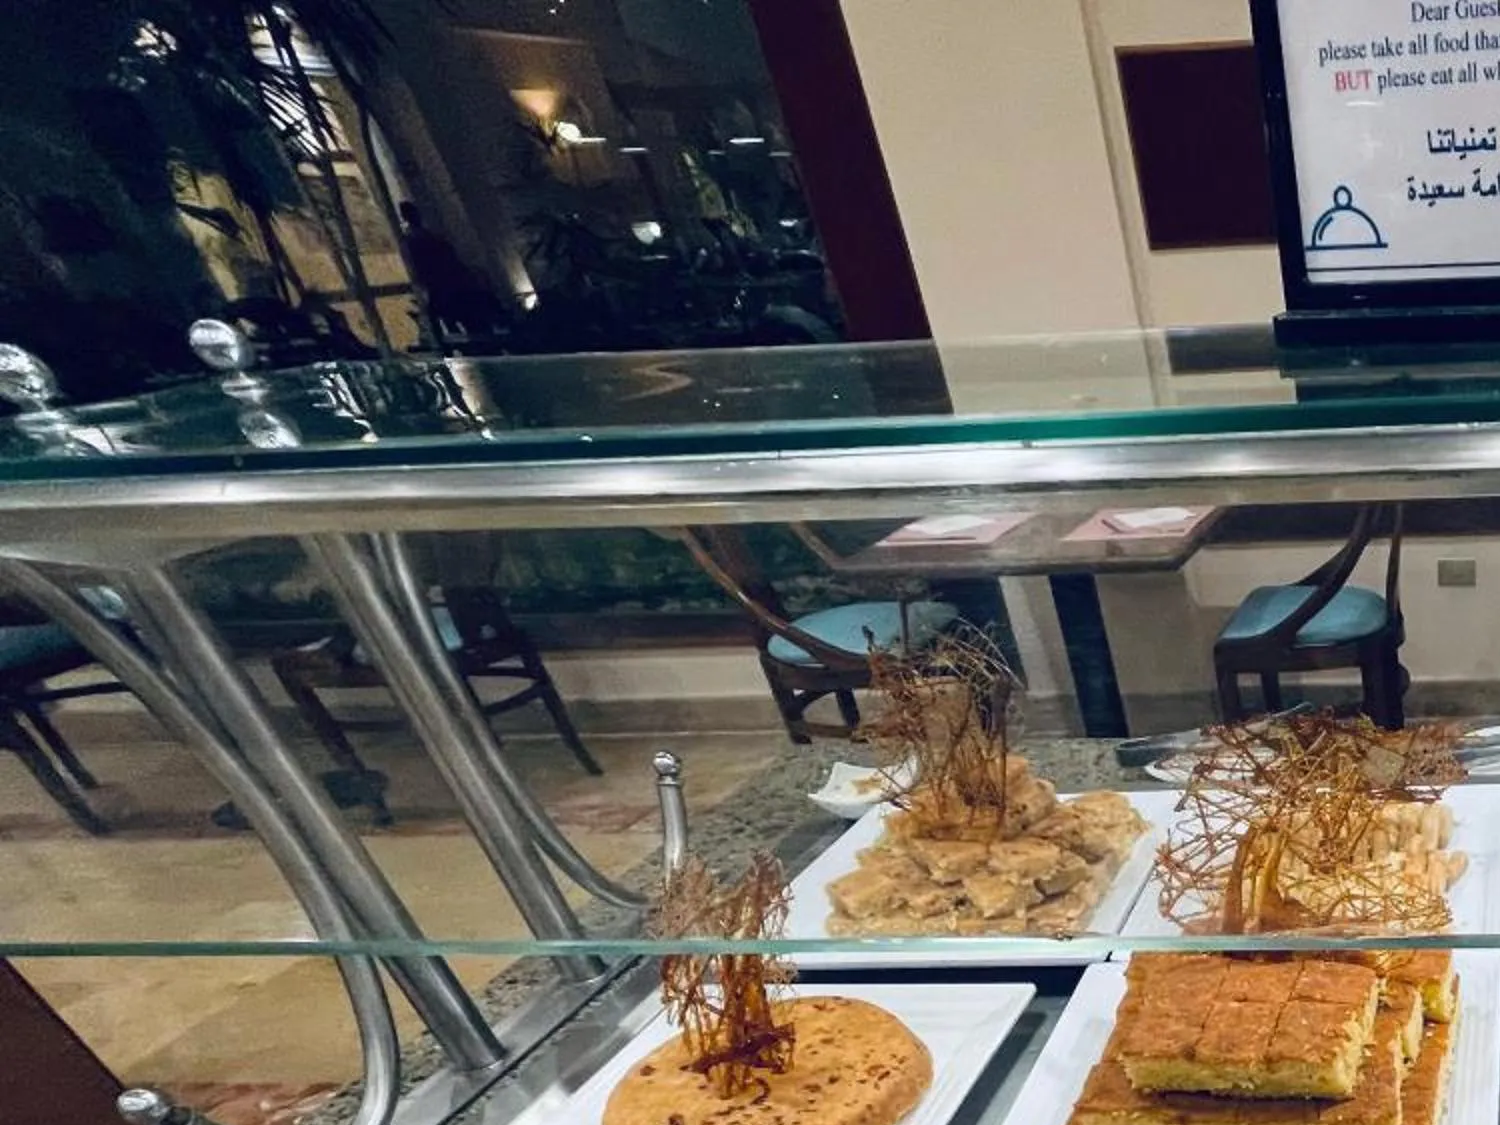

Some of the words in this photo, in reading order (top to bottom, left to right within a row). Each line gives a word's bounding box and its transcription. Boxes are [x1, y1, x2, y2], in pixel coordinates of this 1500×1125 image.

[1411, 1, 1450, 23] Dear
[1318, 40, 1367, 67] please
[1371, 36, 1404, 57] take
[1408, 33, 1428, 55] all
[1434, 30, 1470, 53] food
[1334, 69, 1372, 92] BUT
[1377, 68, 1425, 95] please
[1431, 67, 1453, 85] eat
[1457, 61, 1478, 83] all
[1427, 126, 1497, 160] تمنياتنا
[1407, 176, 1465, 207] سعيدة
